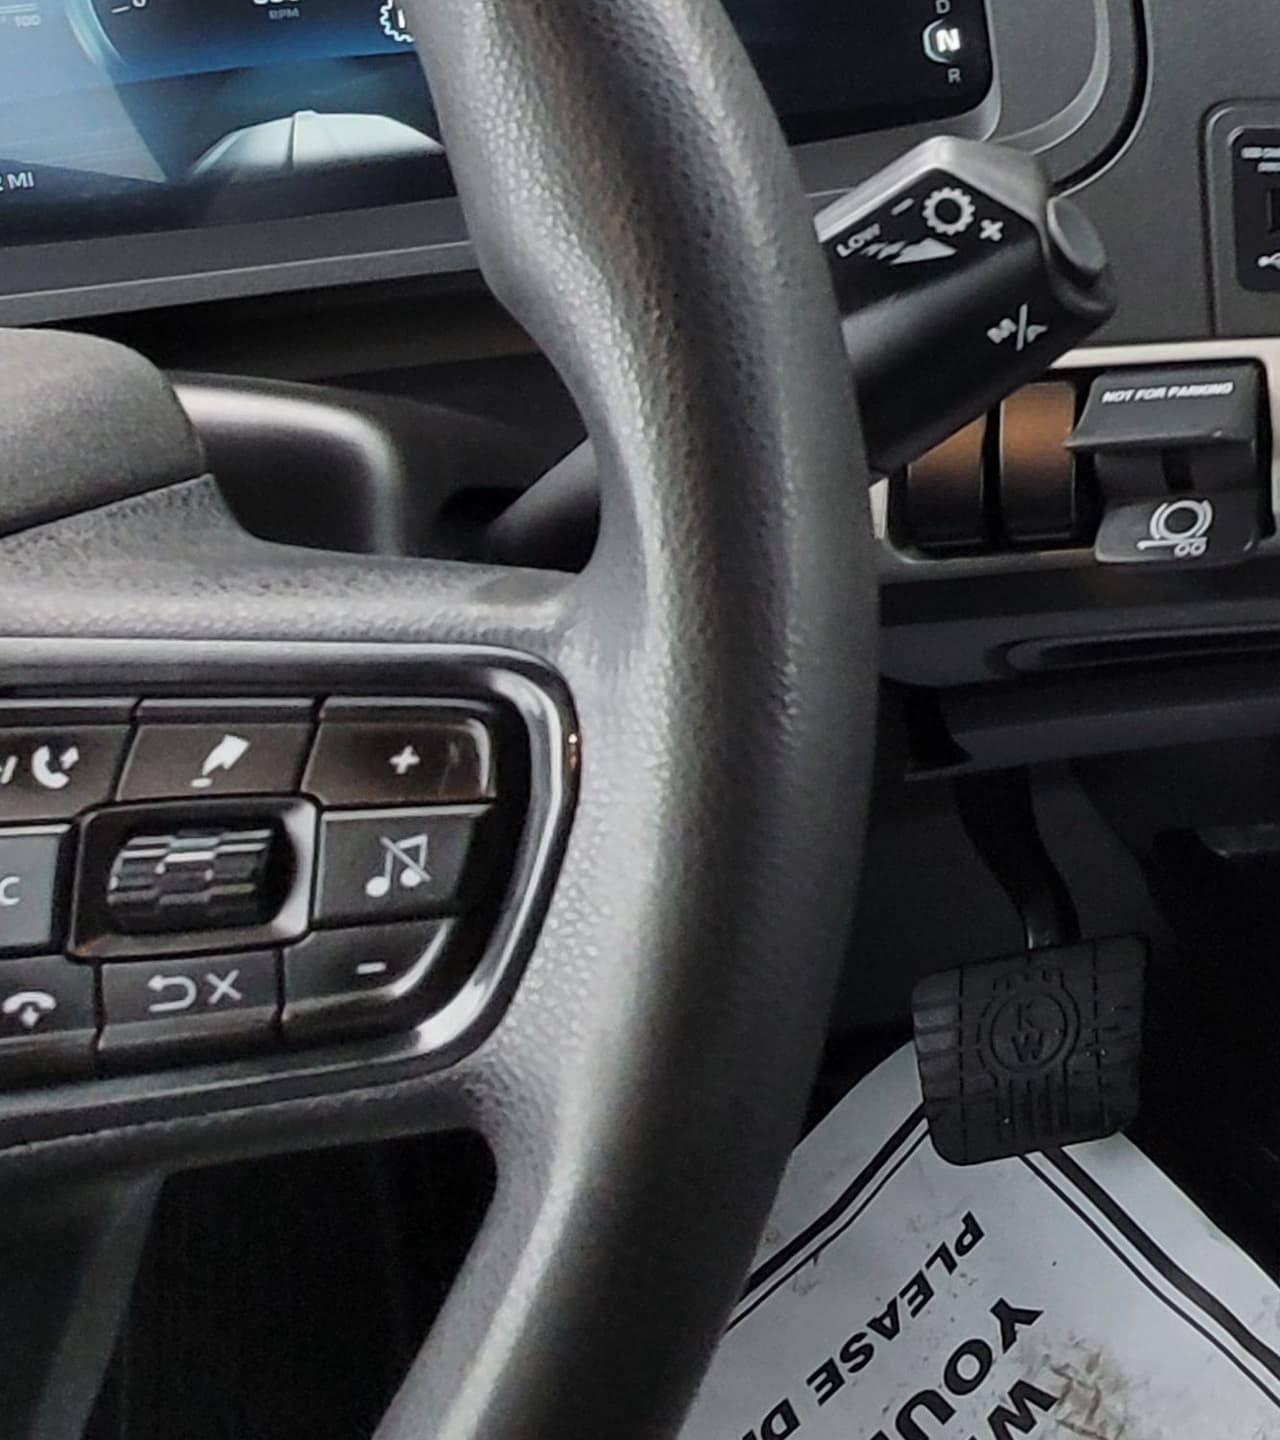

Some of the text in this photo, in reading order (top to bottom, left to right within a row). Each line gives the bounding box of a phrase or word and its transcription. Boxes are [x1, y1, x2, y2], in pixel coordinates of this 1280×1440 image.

[268, 8, 299, 20] RPM
[935, 27, 961, 53] N
[948, 68, 961, 83] R
[7, 171, 35, 189] MI
[1102, 381, 1234, 403] NOT FOR PARKING
[806, 1210, 986, 1407] PLEASE
[866, 1297, 1045, 1440] YOU
